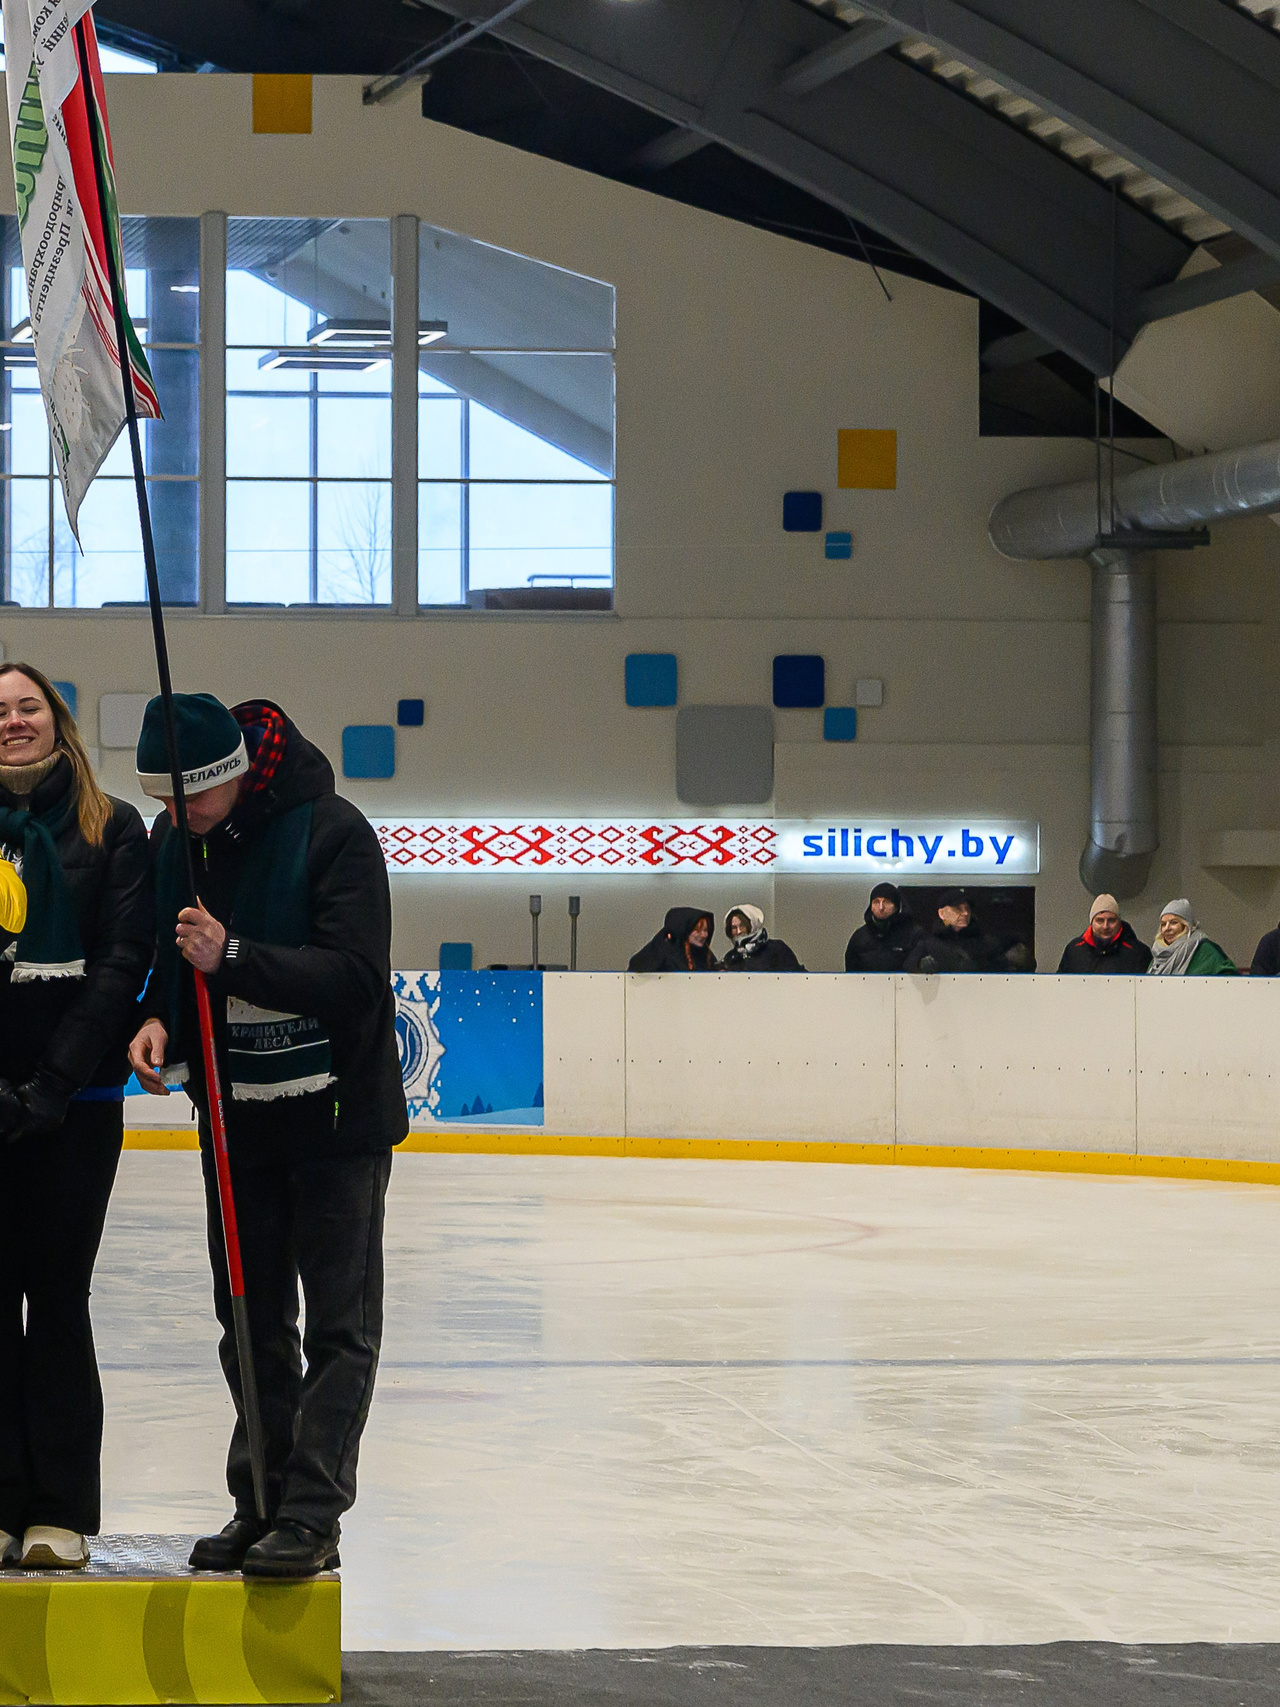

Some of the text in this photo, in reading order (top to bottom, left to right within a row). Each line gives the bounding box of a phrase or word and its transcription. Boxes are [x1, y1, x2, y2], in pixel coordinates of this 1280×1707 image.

[182, 758, 242, 785] БЕЛАРУСЬ
[803, 828, 1015, 864] silichy.by
[254, 1034, 292, 1049] ЛЕСА
